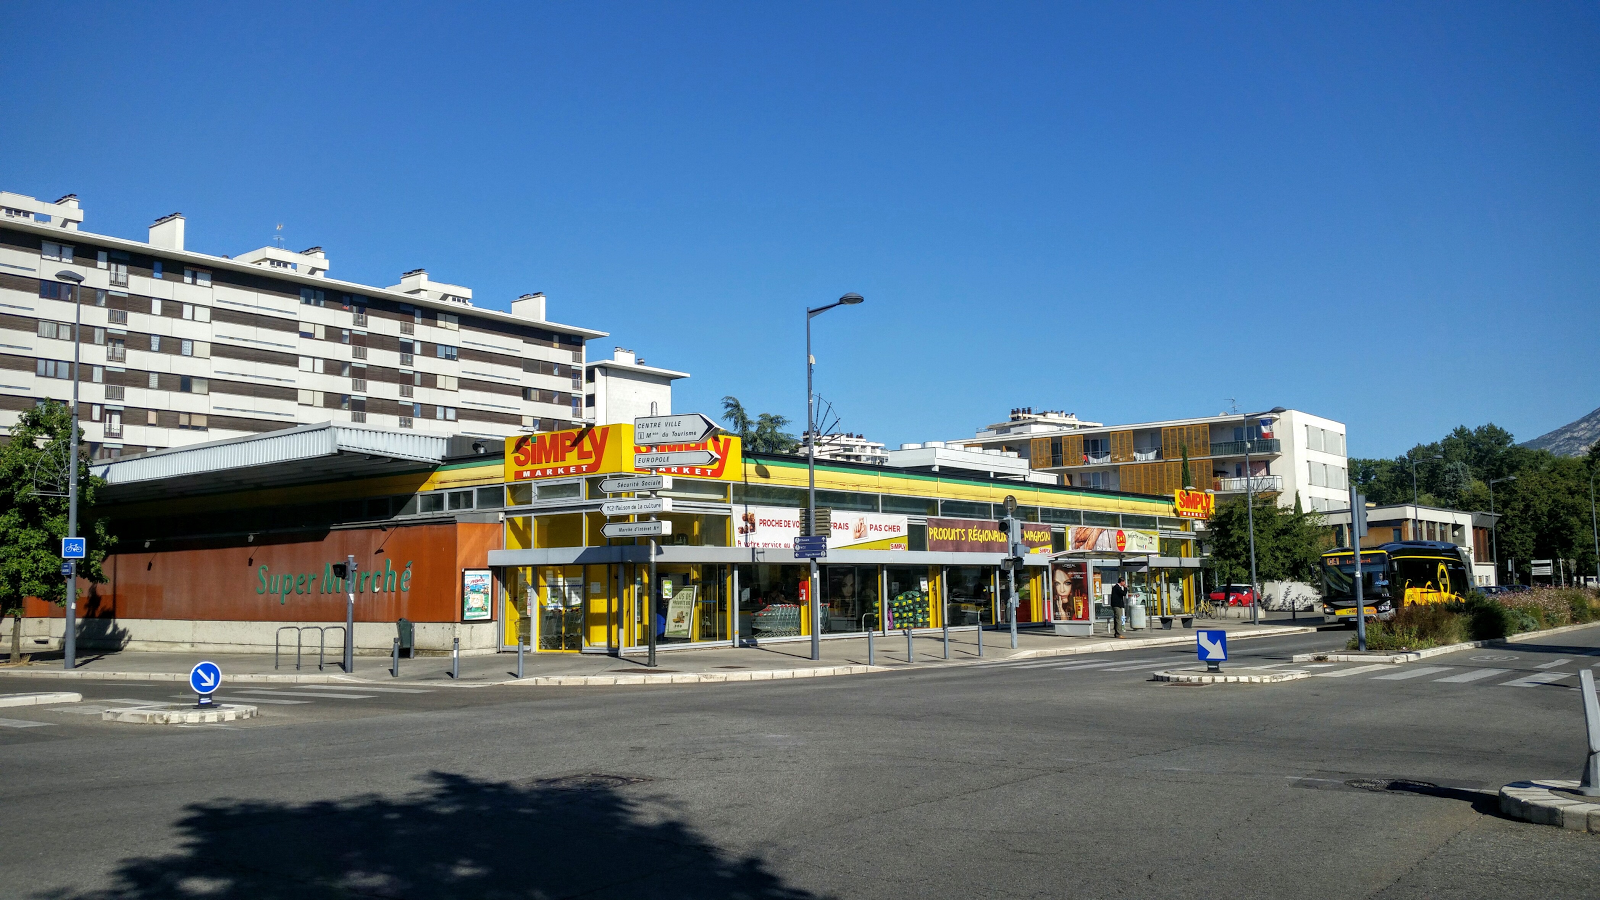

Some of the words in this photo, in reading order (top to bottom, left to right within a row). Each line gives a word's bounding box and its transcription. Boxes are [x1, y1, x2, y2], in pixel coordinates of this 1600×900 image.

[523, 465, 588, 478] MARKET
[759, 519, 783, 528] PROCHE
[784, 520, 791, 528] DE
[869, 524, 882, 534] PAS
[884, 524, 901, 533] CHER
[929, 527, 966, 542] PRODUITS
[968, 525, 1007, 543] RÉGIONAUX
[1024, 530, 1051, 543] MAGASIN
[256, 565, 317, 605] Super
